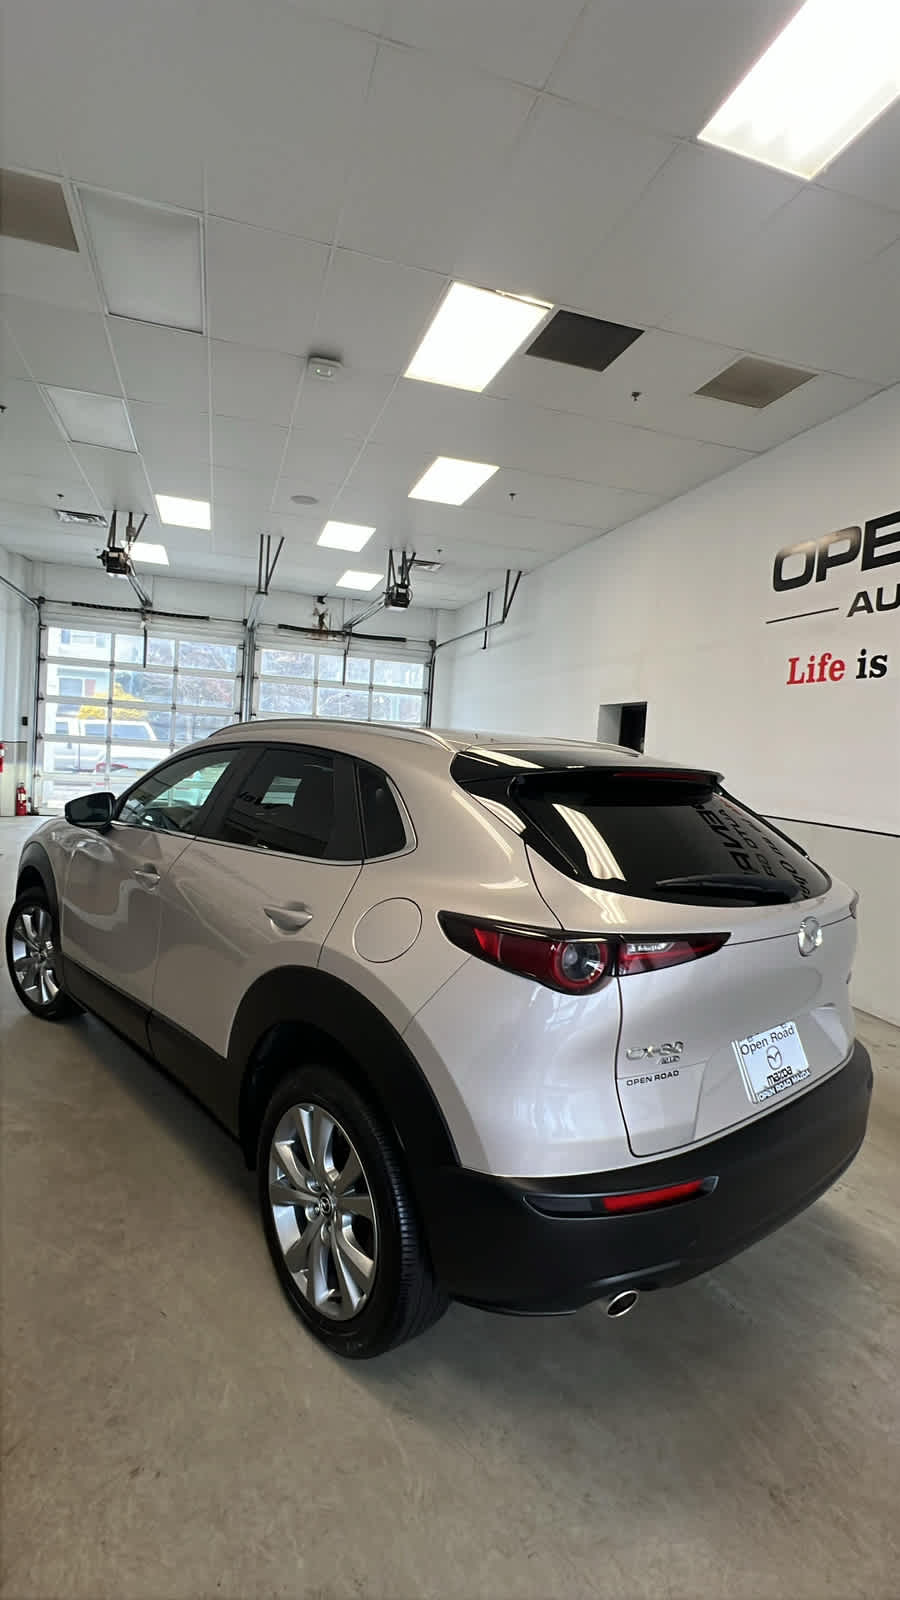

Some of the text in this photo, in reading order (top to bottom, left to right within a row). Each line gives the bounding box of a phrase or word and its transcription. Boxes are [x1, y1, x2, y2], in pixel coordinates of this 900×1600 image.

[786, 648, 888, 685] Life is
[740, 1024, 795, 1056] Open Road
[626, 1069, 680, 1087] OPEN ROAD
